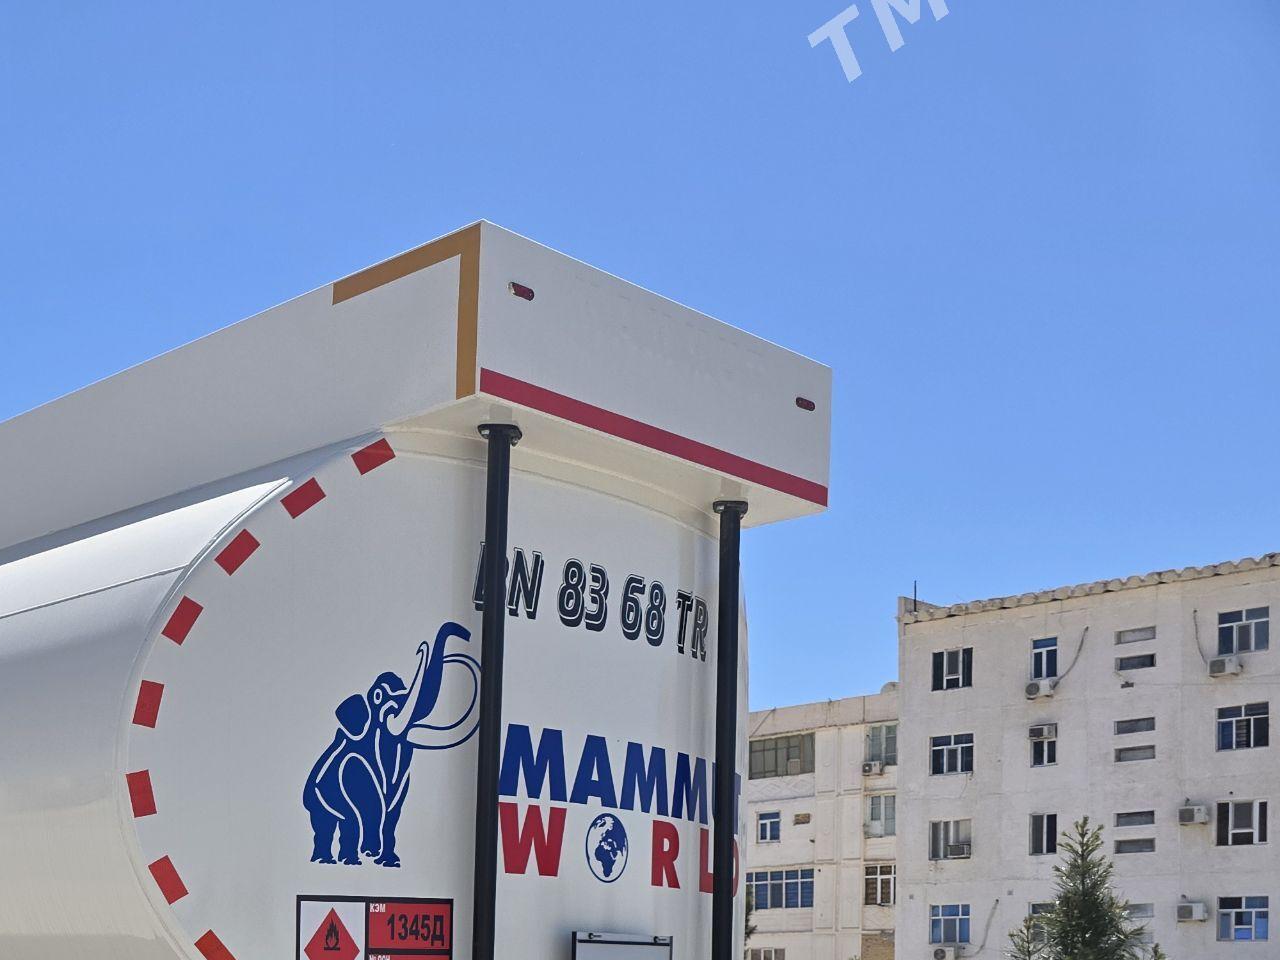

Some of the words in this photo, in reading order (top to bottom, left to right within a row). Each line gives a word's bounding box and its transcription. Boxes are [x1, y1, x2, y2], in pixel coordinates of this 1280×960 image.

[557, 557, 610, 632] 83
[621, 573, 667, 647] 68
[677, 588, 709, 662] TR
[498, 723, 742, 836] MAMMT
[498, 801, 740, 898] WORL
[387, 913, 445, 946] 1345Д
